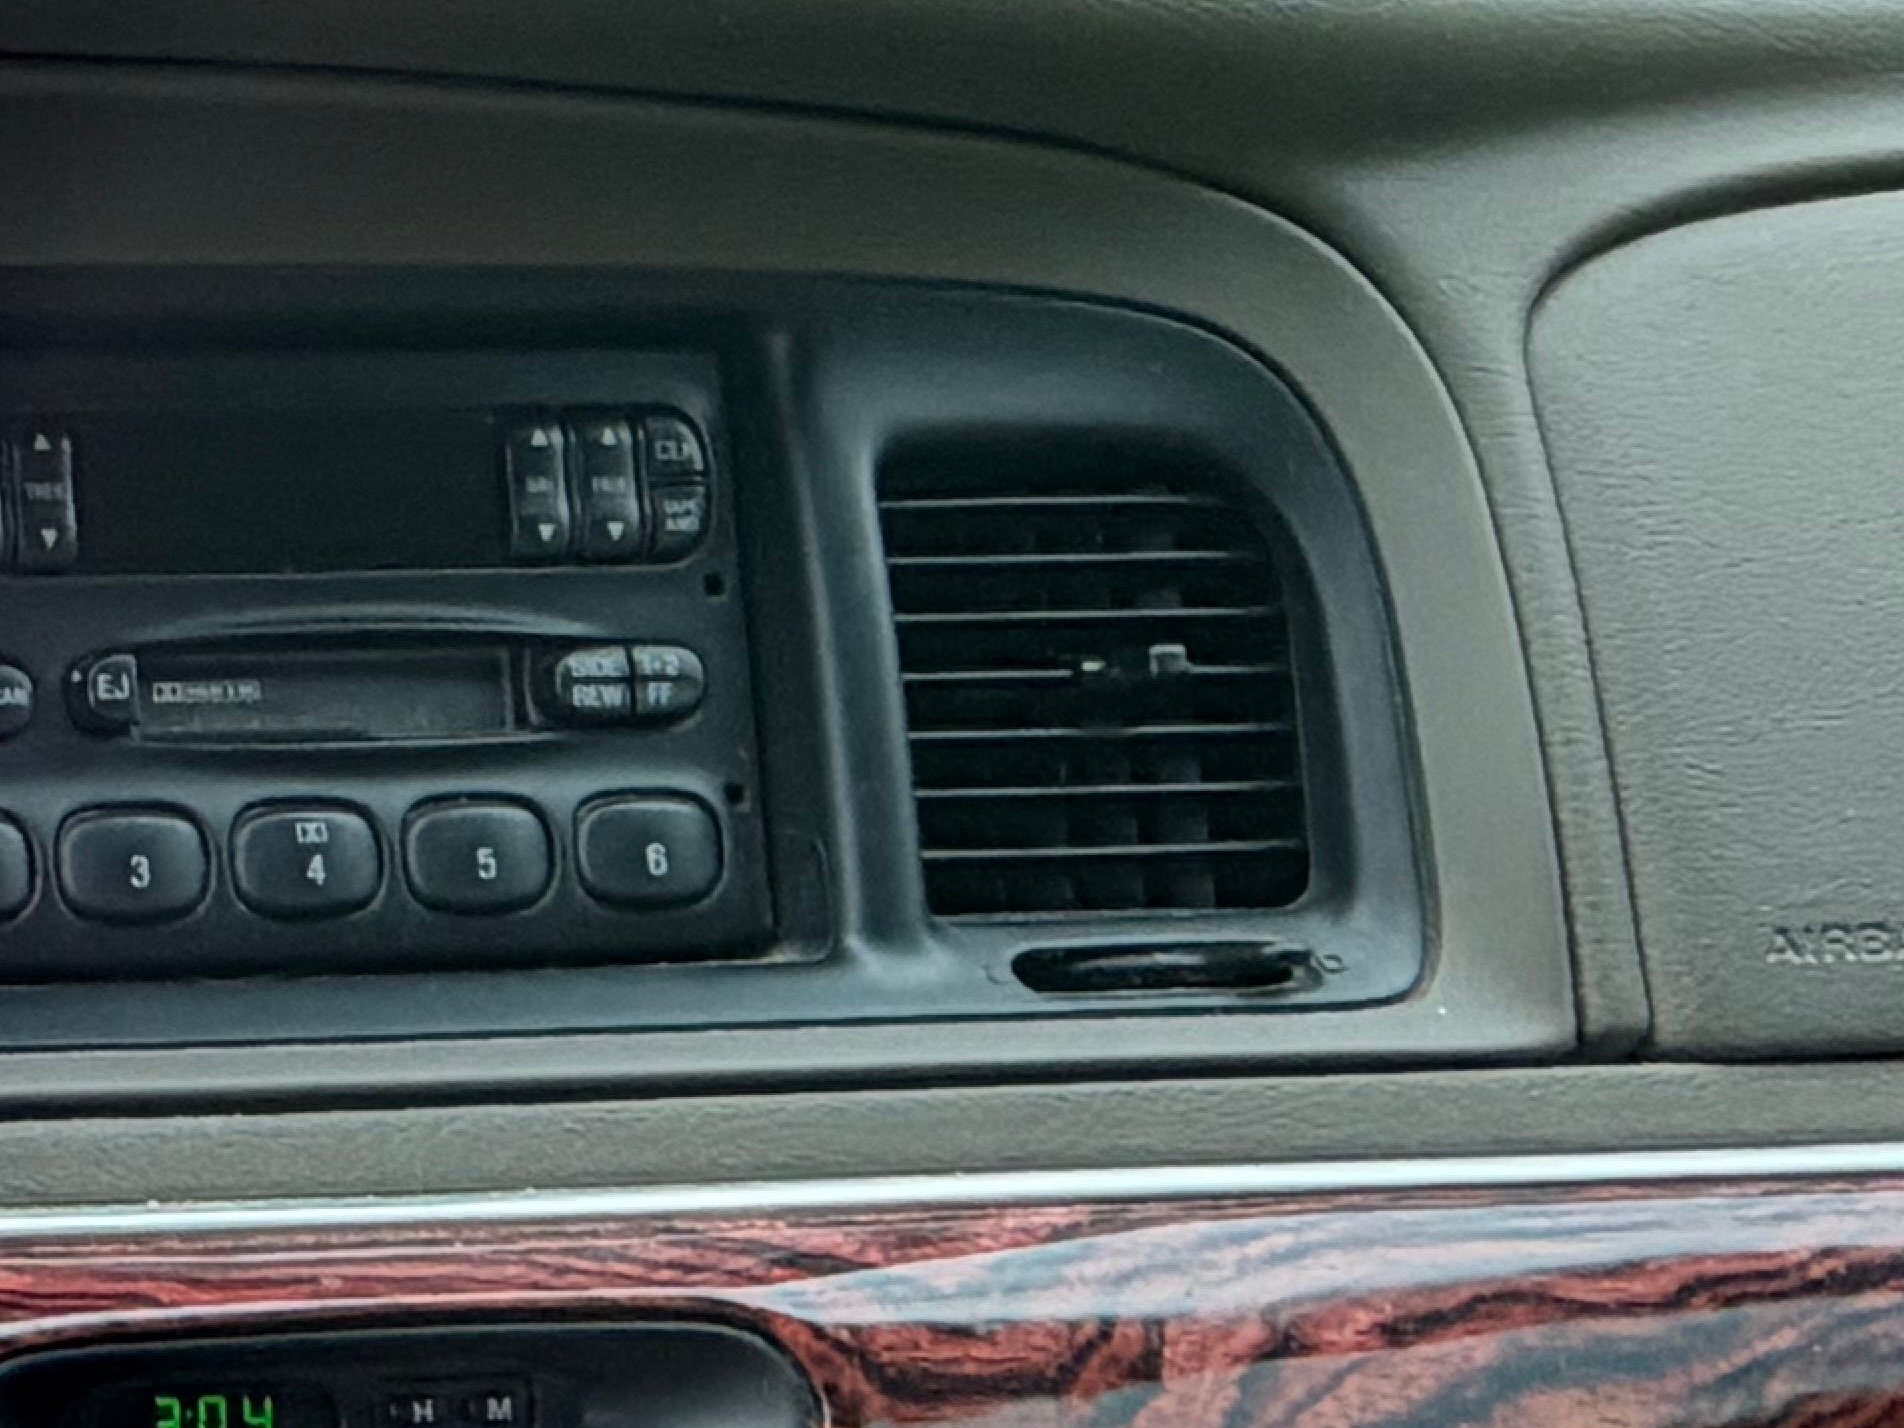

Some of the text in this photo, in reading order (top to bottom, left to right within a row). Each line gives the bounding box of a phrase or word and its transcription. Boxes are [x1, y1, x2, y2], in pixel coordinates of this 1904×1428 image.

[97, 675, 130, 699] EJ
[130, 855, 151, 887] 3
[307, 854, 326, 884] 4
[477, 848, 496, 879] 5
[645, 843, 668, 874] 6
[1765, 922, 1904, 965] AIRB
[413, 1400, 433, 1421] H
[488, 1398, 511, 1420] M
